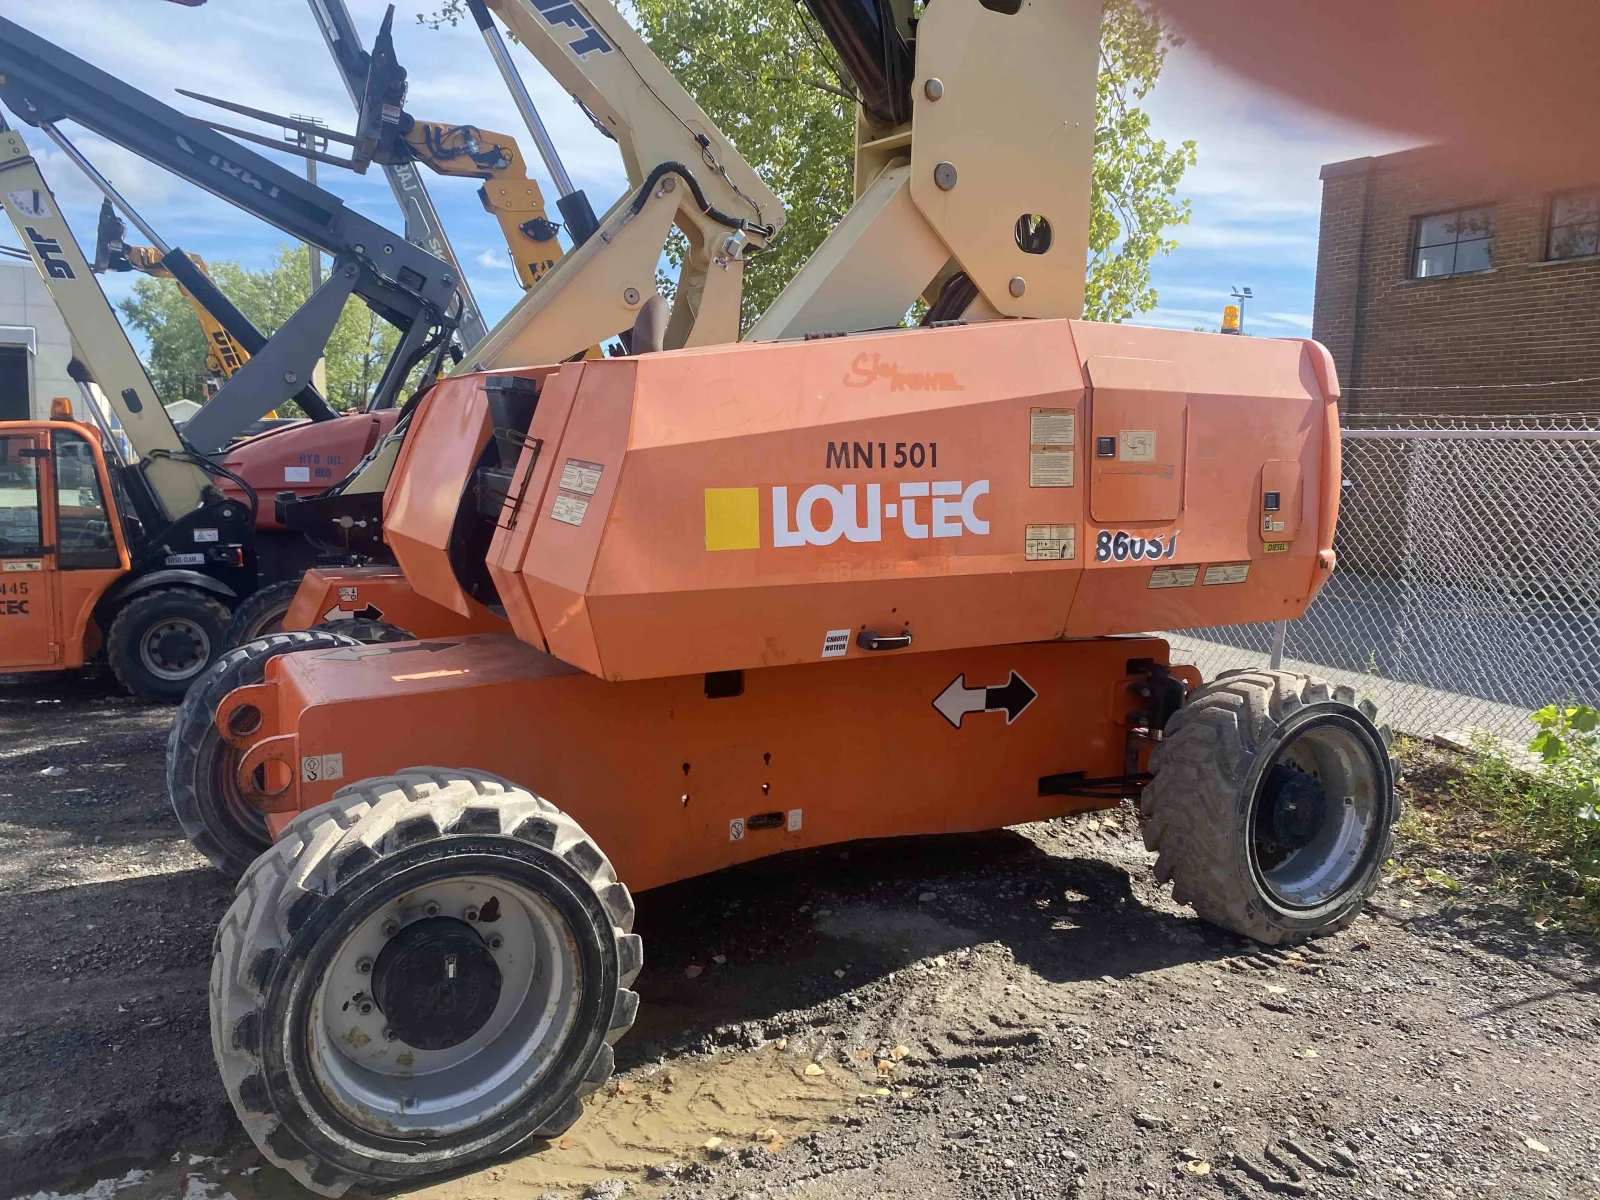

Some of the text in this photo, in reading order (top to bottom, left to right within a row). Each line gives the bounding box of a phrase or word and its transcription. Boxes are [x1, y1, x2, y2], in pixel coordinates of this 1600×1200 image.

[24, 226, 77, 280] JLG
[825, 441, 937, 469] MN1501
[772, 479, 990, 548] LOU-TEC
[1267, 543, 1285, 552] DIESEL
[824, 644, 846, 652] MOTEUR
[826, 635, 849, 643] CHAUFFE
